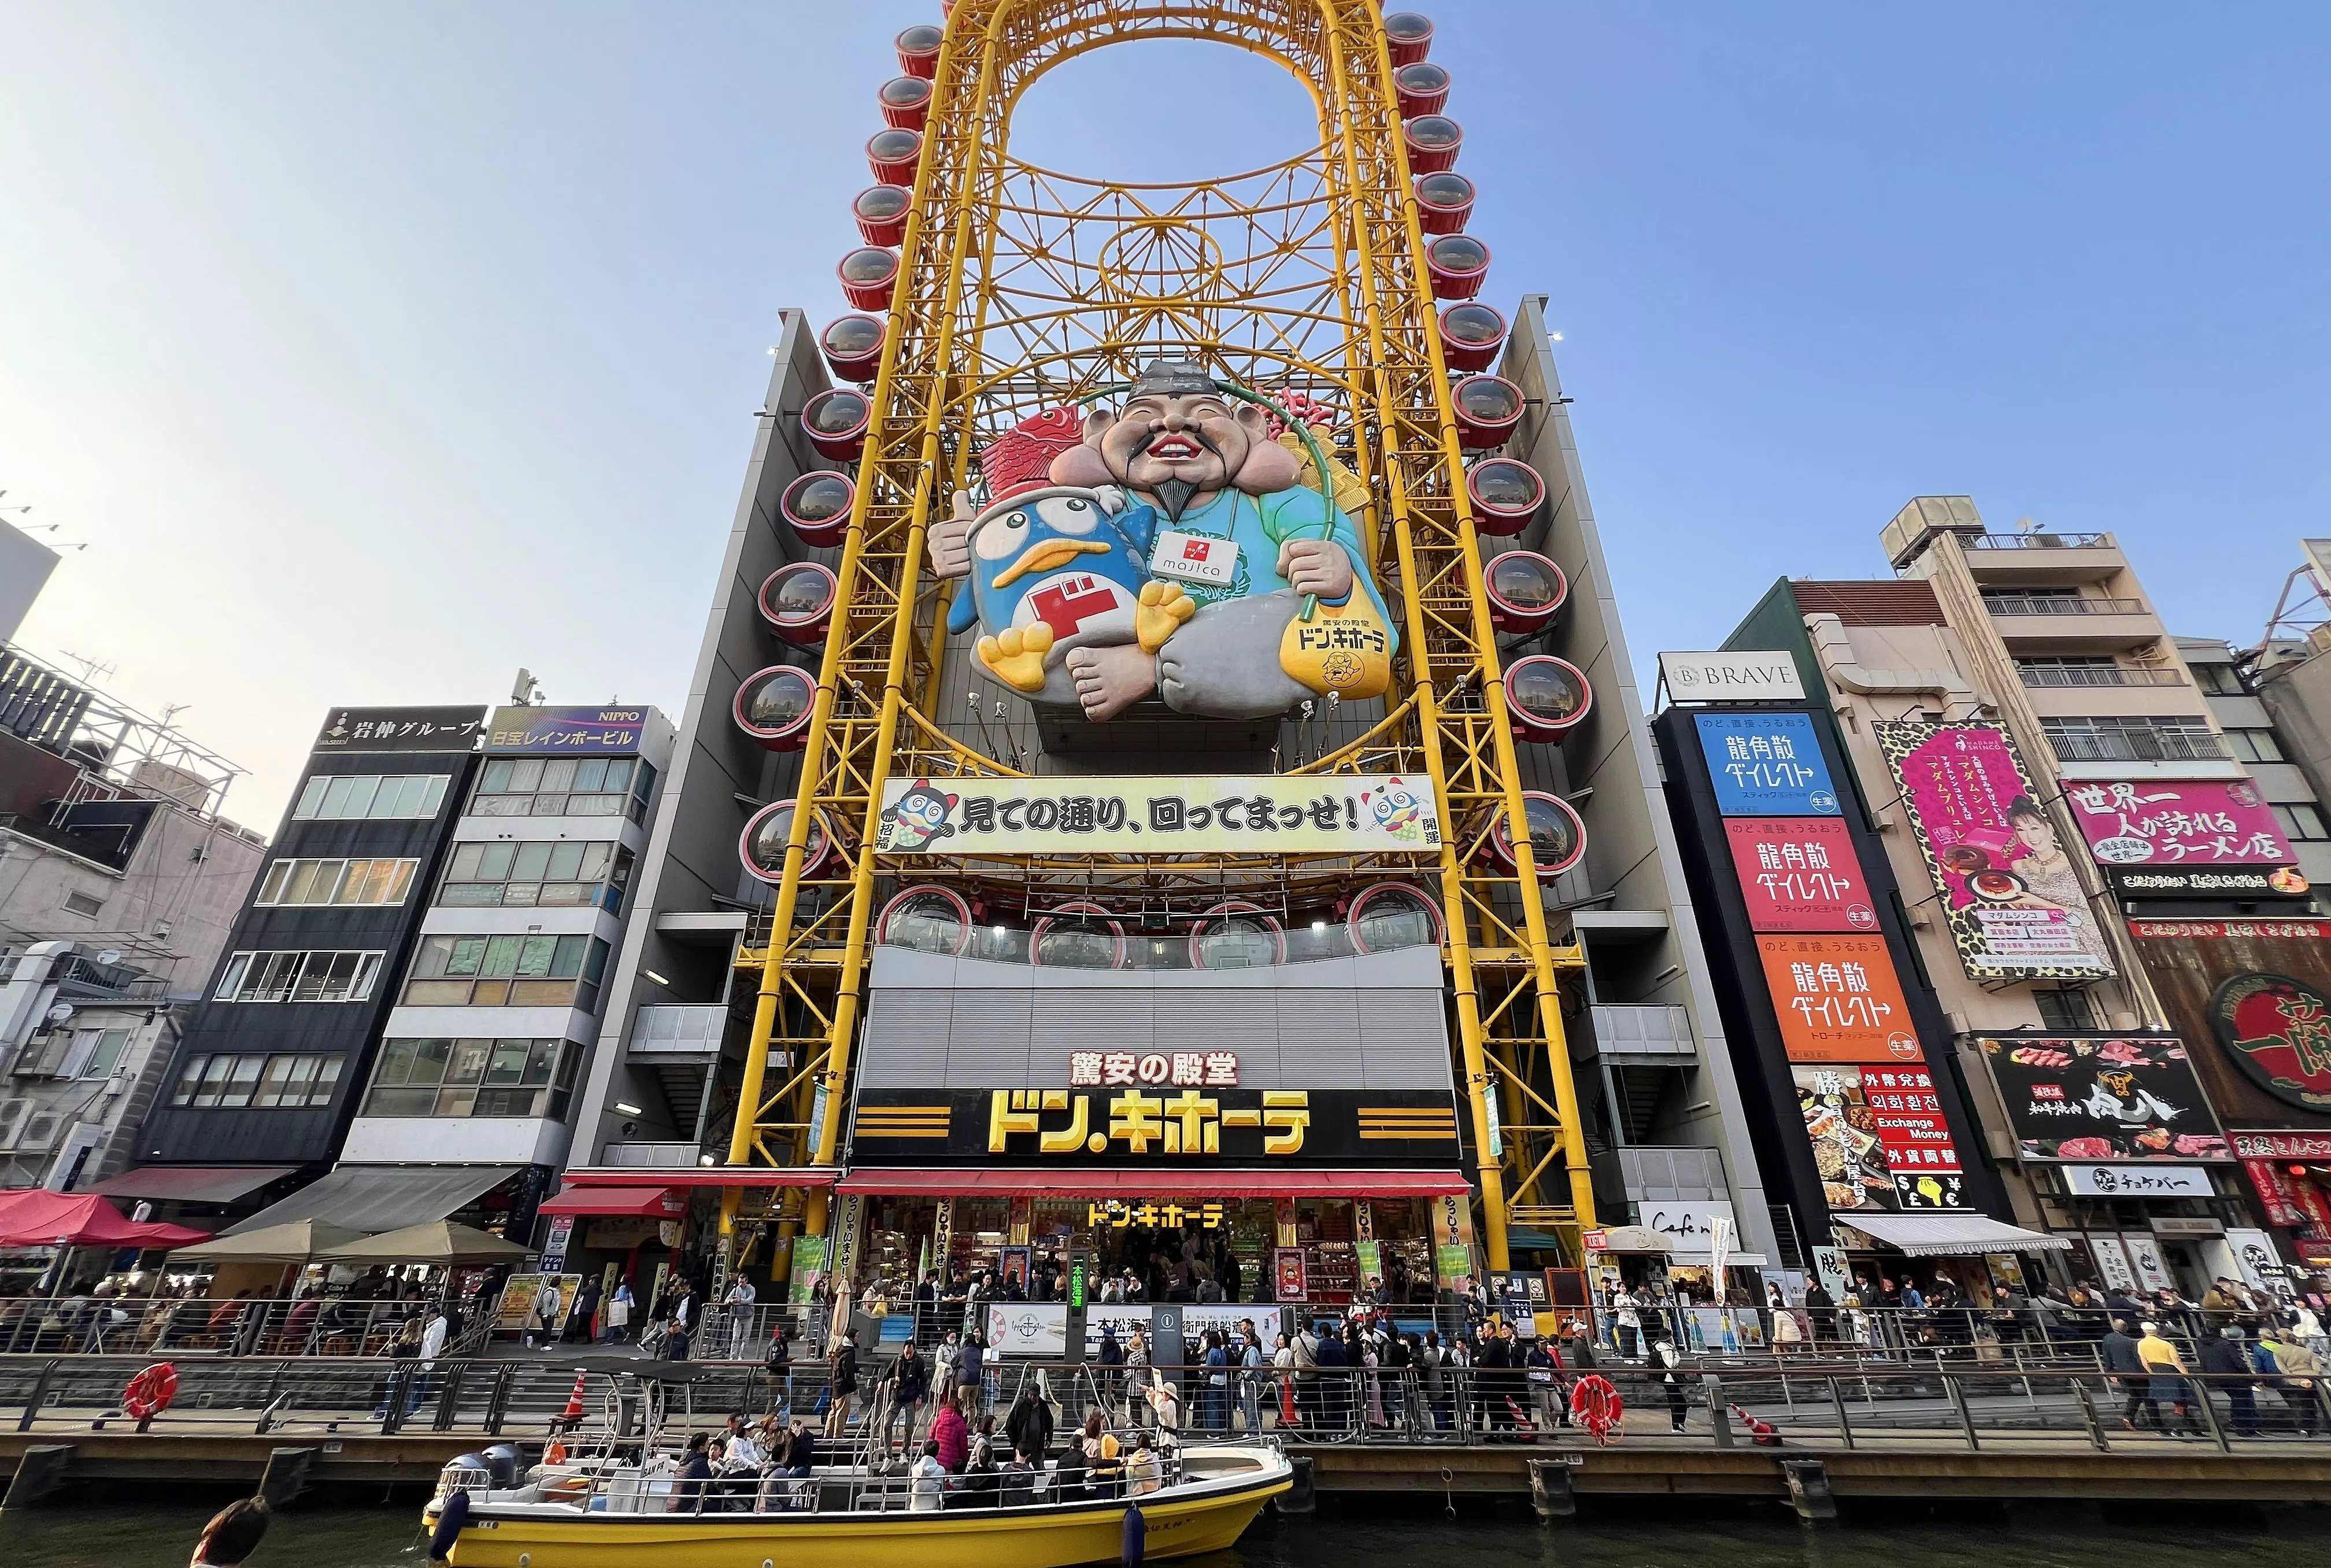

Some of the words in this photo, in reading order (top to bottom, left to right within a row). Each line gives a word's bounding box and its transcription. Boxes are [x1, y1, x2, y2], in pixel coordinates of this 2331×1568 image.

[1704, 666, 1793, 685] BRAVE
[598, 711, 639, 721] NIPPO
[491, 730, 633, 746] 日宝レインボービル
[1725, 735, 1796, 760] 龍角散
[1812, 797, 1834, 807] 生薬
[2073, 782, 2181, 814] 世界一
[1420, 817, 1442, 845] 開運
[2119, 811, 2238, 837] 人が訪れる
[875, 823, 893, 850] 招福
[2162, 832, 2283, 860] ラーメン店
[1756, 842, 1832, 869] 龍角散
[1849, 911, 1873, 921] 生薬
[1790, 962, 1871, 992] 龍角散
[1890, 1040, 1916, 1051] 生薬
[1071, 1051, 1238, 1085] 驚安の殿堂
[1865, 1073, 1933, 1087] 外幣兌換
[1877, 1118, 1934, 1129] Exchange
[1910, 1129, 1948, 1140] Money
[1888, 1149, 1957, 1164] 外貨両替
[1898, 1176, 1910, 1190] $
[1947, 1177, 1962, 1191] ¥
[1909, 1193, 1922, 1206] £
[1946, 1193, 1959, 1206] €
[1652, 1211, 1694, 1237] Cafe
